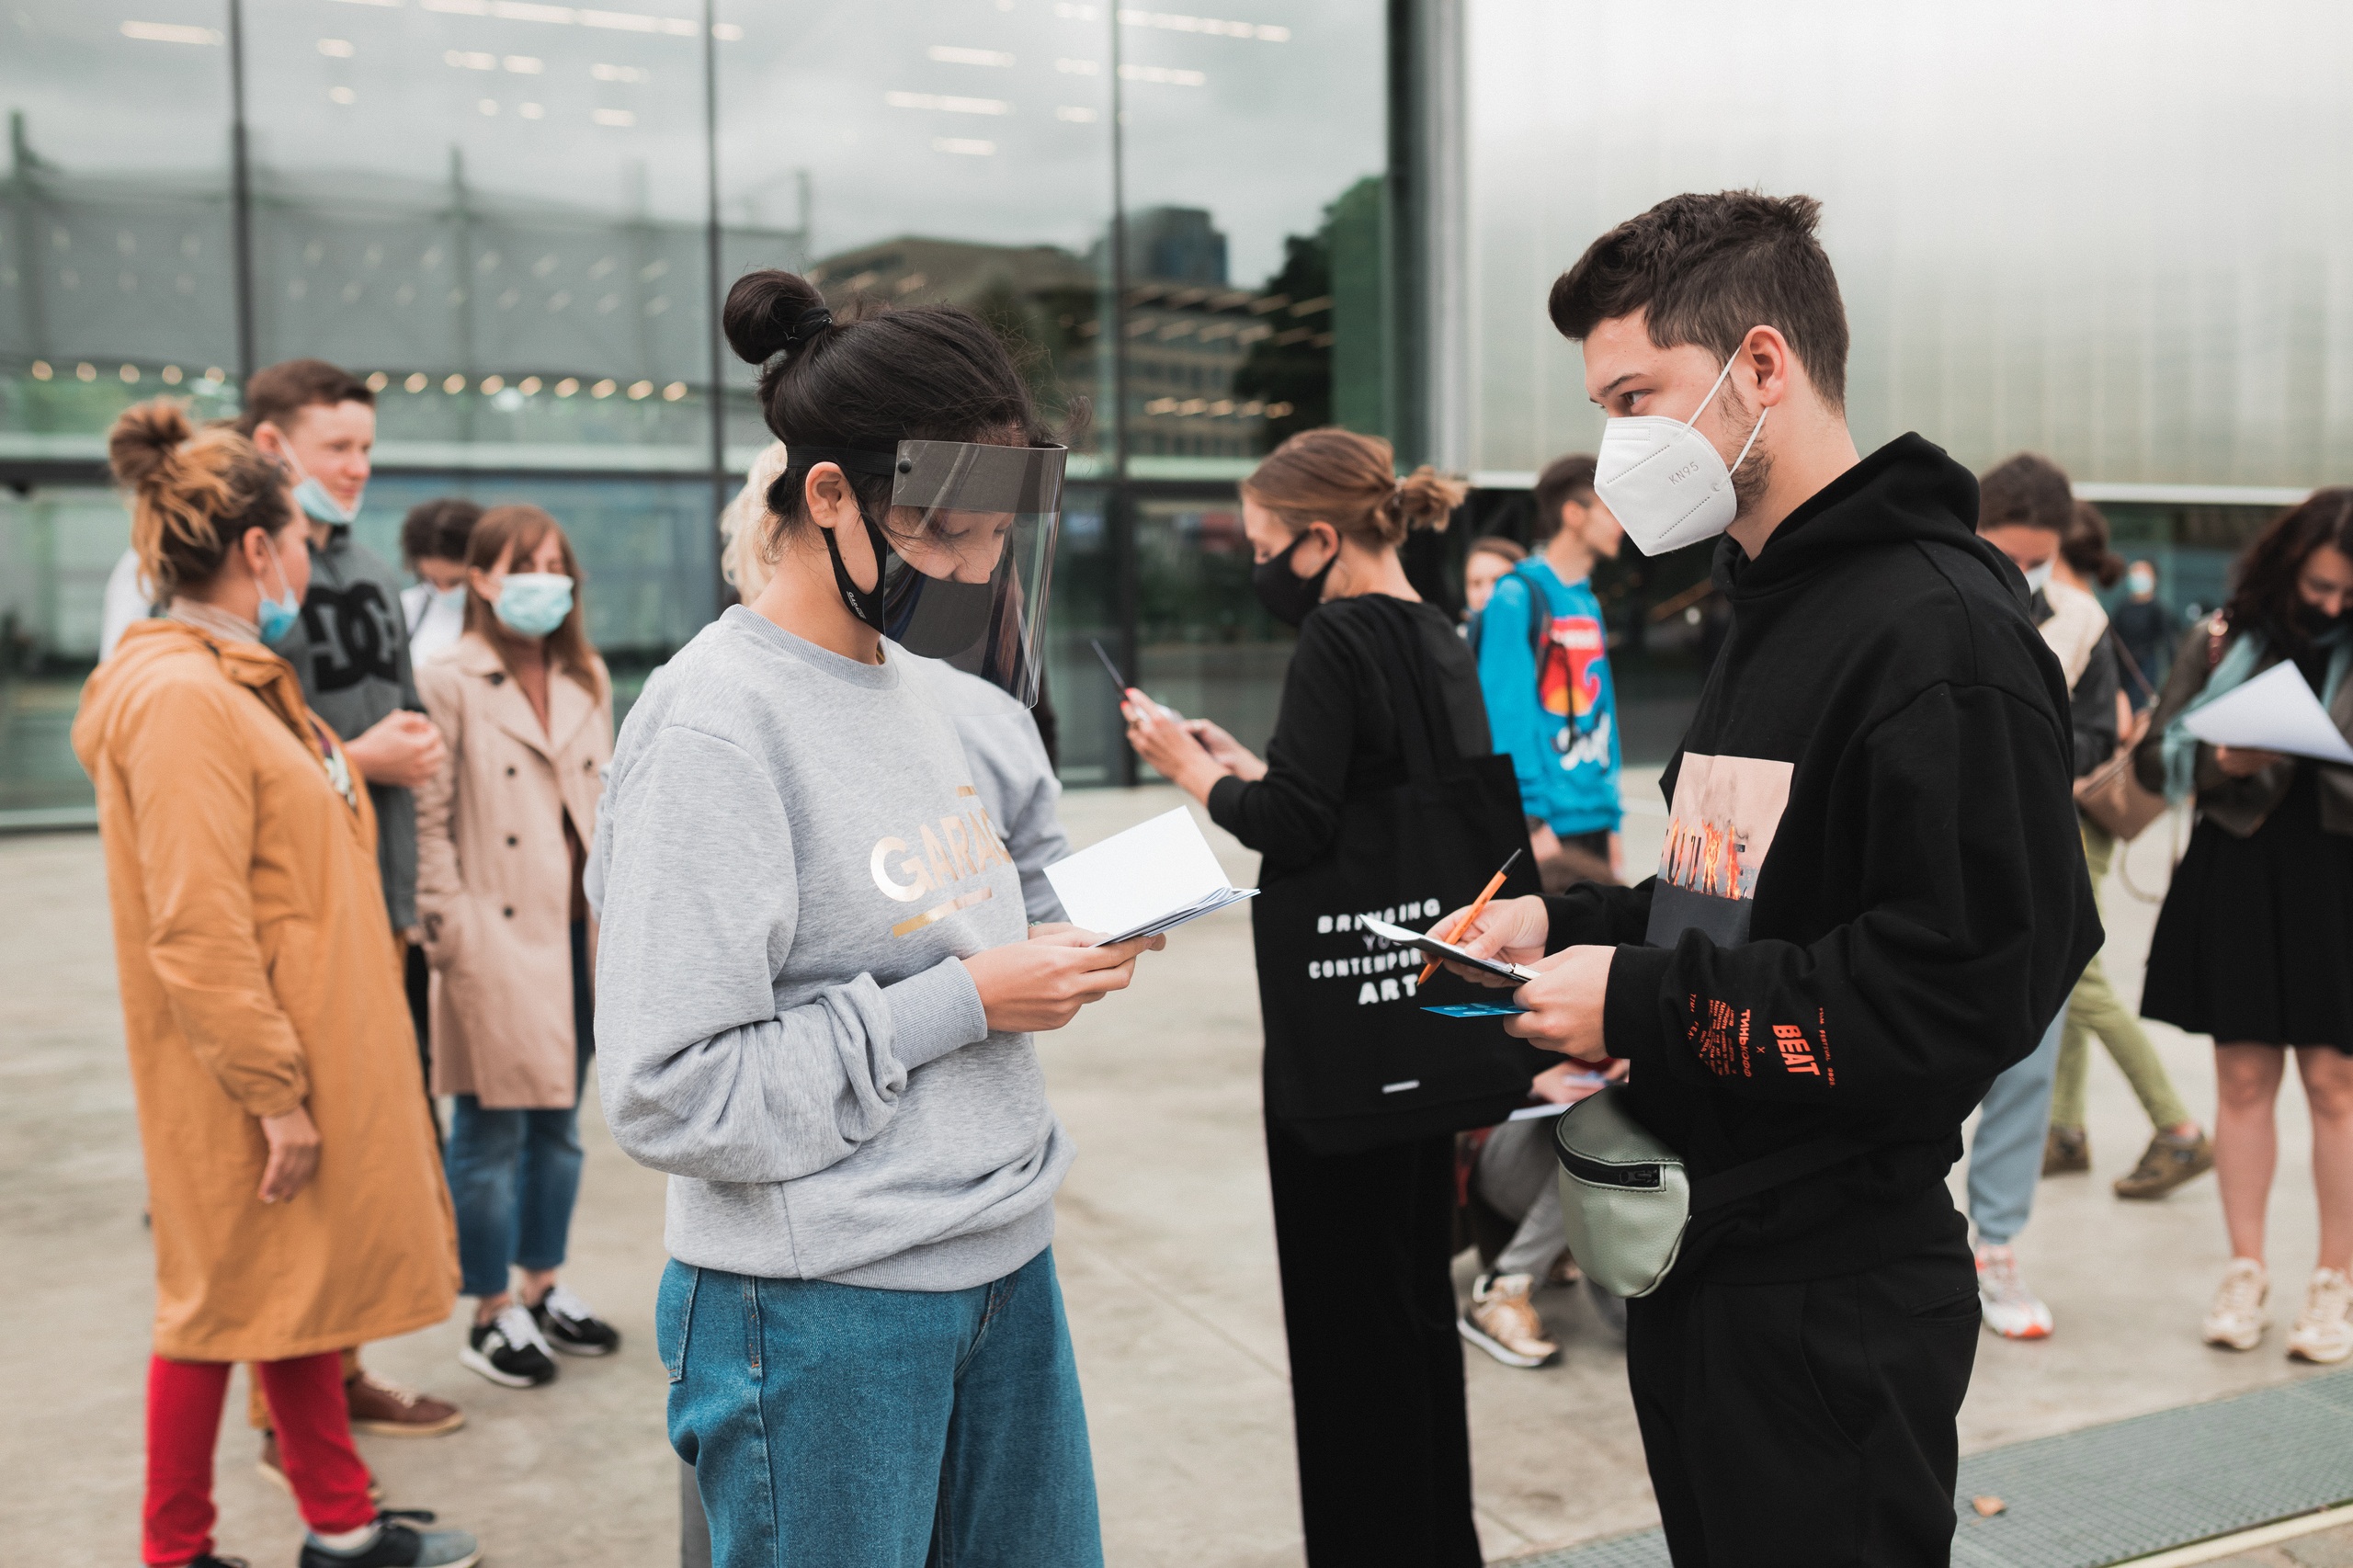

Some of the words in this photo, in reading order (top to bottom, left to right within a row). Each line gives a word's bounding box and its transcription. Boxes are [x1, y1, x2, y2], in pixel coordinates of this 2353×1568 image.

[1668, 461, 1700, 485] KN95
[1317, 898, 1441, 934] BRINGING
[1358, 972, 1419, 1006] ART
[1716, 1002, 1727, 1029] FEATURING
[1738, 1008, 1752, 1077] ТИНЬКОФФ
[1771, 1024, 1822, 1076] BEAT
[1819, 1029, 1832, 1062] FESTIVAL
